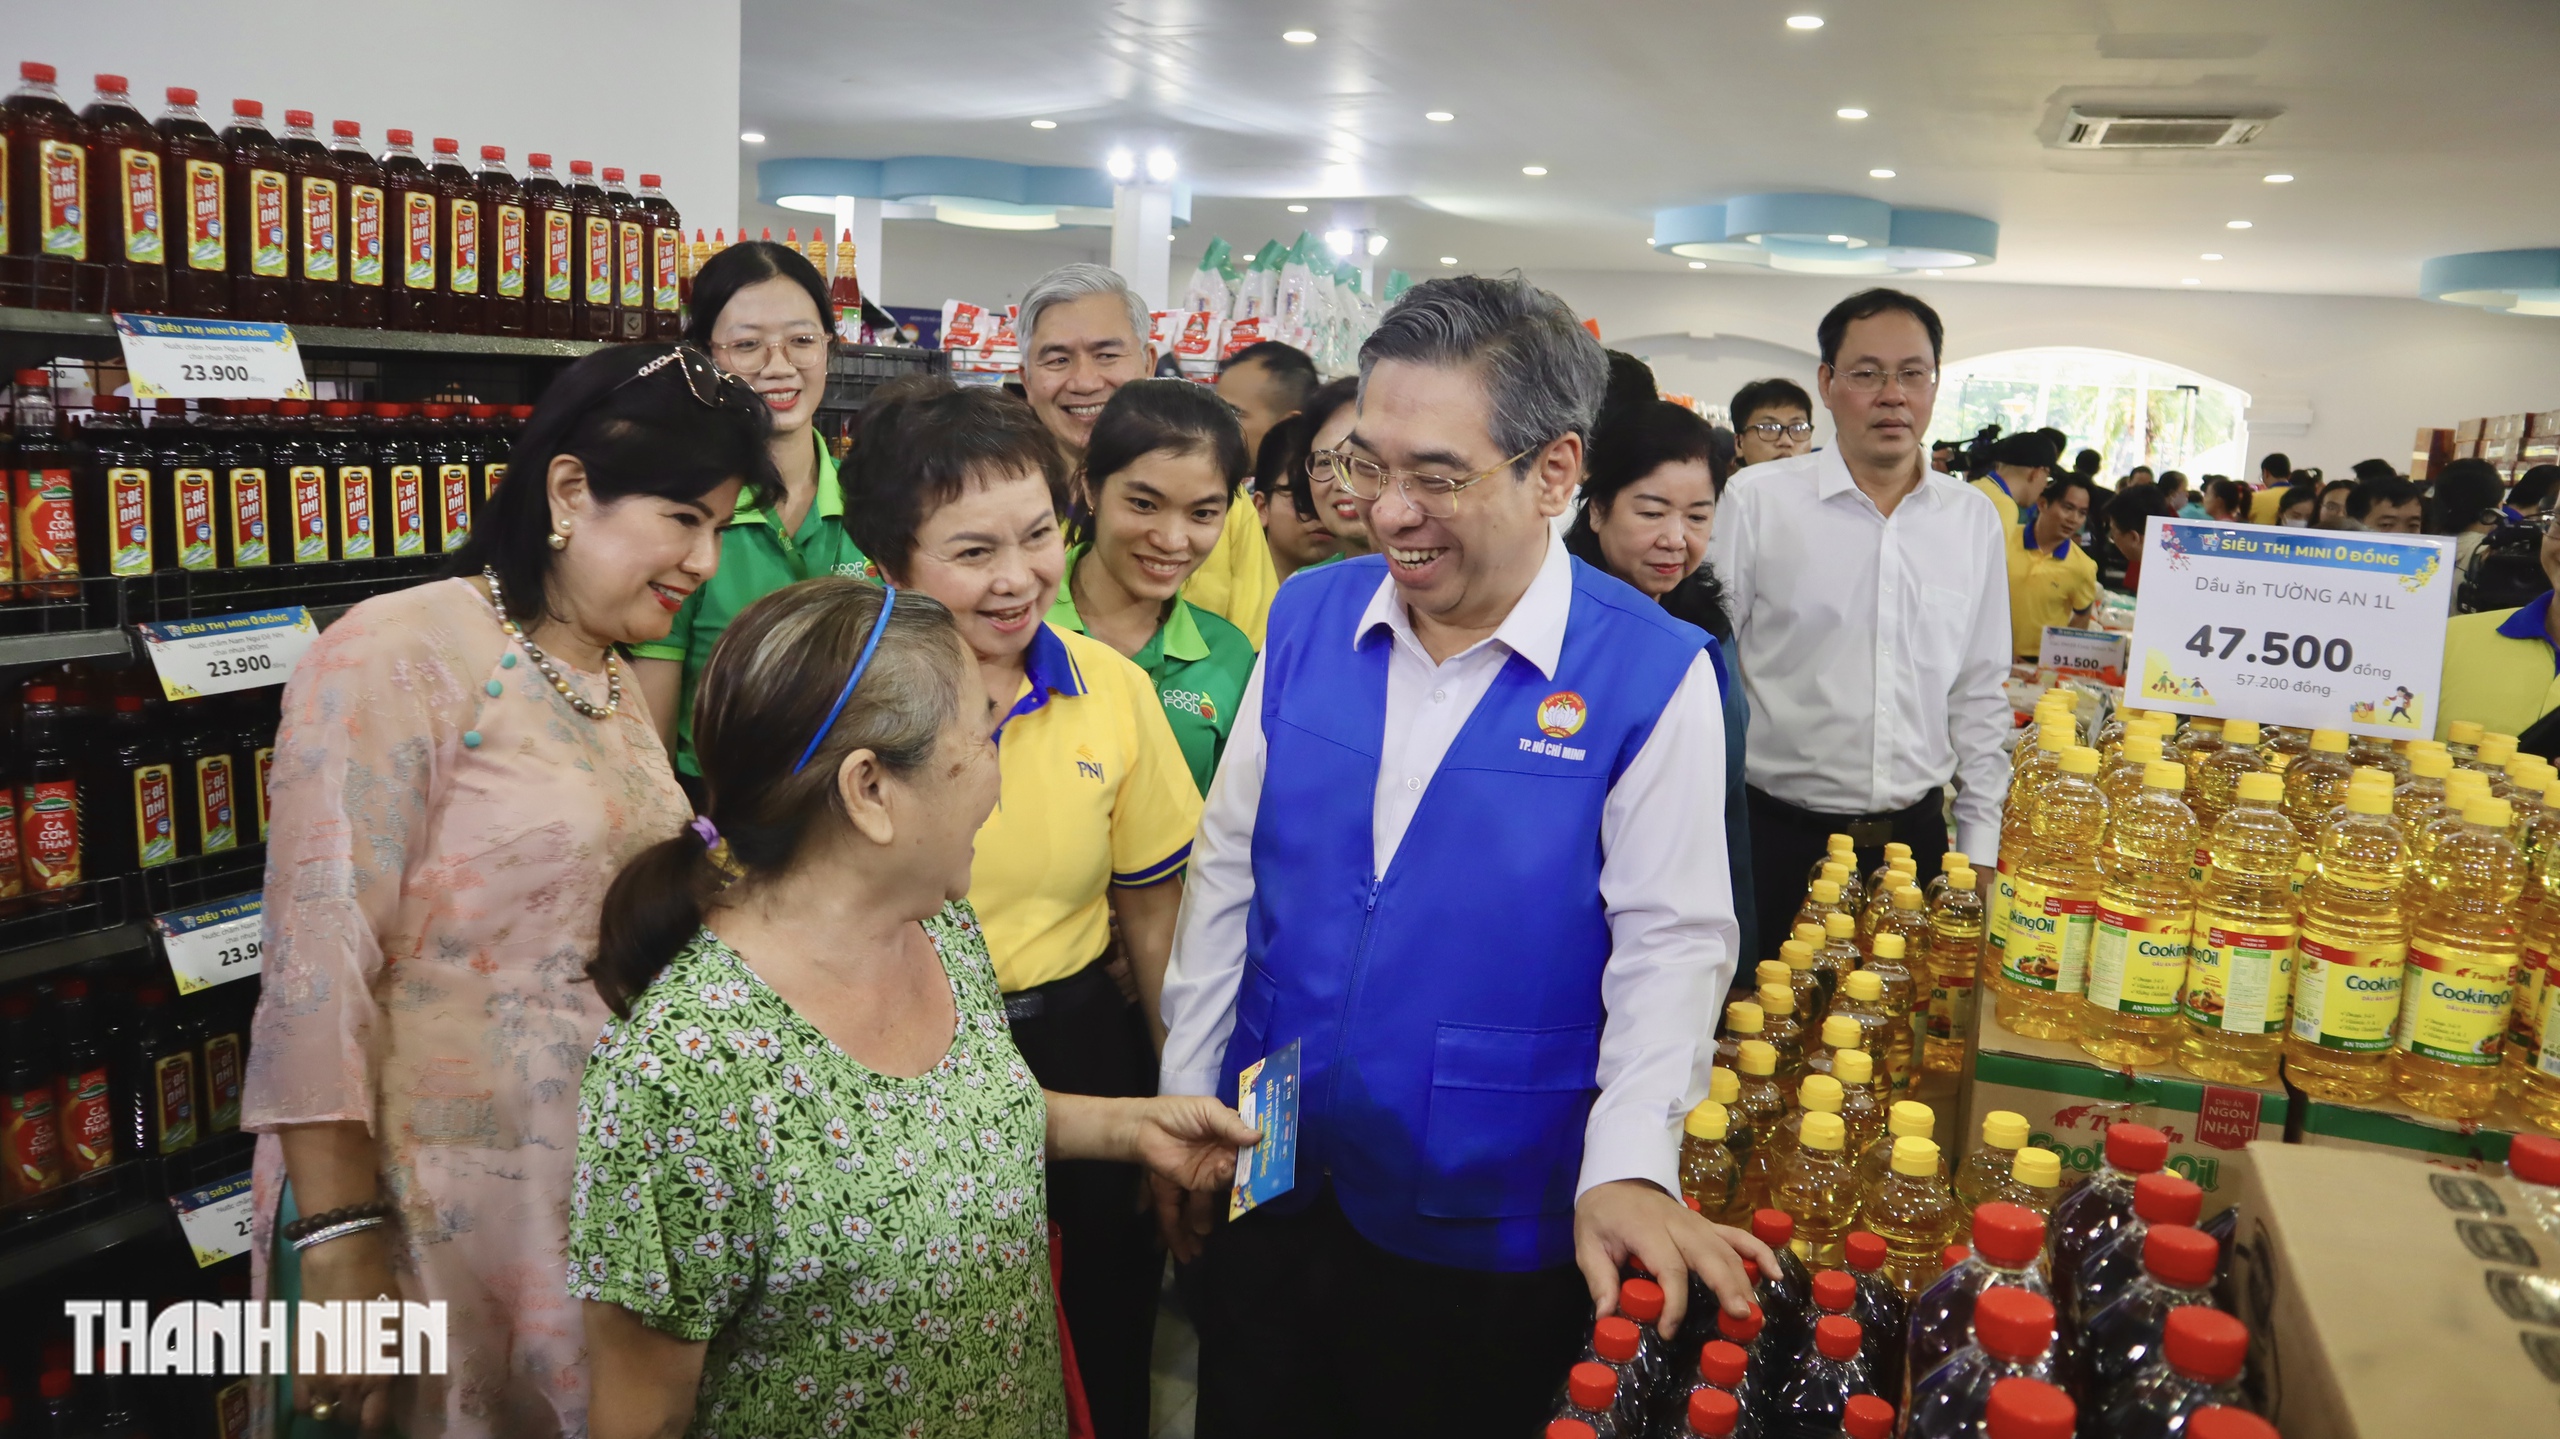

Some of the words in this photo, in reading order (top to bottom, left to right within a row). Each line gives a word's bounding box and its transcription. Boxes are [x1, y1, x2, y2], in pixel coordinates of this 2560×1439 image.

[157, 323, 183, 333] SIÊU
[185, 325, 204, 336] THỊ
[206, 326, 229, 336] MINI
[230, 326, 239, 336] 0
[241, 327, 271, 338] ĐỒNG
[181, 364, 249, 382] 23.900
[2221, 538, 2258, 553] SIÊU
[2262, 542, 2290, 558] THỊ
[2295, 546, 2332, 559] MINI
[2334, 546, 2348, 561] 0
[2349, 548, 2400, 566] ĐỒNG
[2195, 576, 2230, 593] Dầu
[2236, 580, 2256, 596] ăn
[2262, 580, 2332, 603] TƯỜNG
[2337, 591, 2367, 607] AN
[2374, 594, 2396, 610] 1L
[181, 623, 207, 635] SIÊU
[207, 622, 226, 631] THỊ
[227, 619, 250, 629] MINI
[251, 616, 260, 626] 0
[261, 614, 290, 624] ĐỒNG
[2053, 655, 2100, 670] 91.500
[2185, 624, 2354, 673] 47.500
[2353, 664, 2392, 681] đồng
[207, 654, 271, 678] 23.900
[2236, 673, 2289, 691] 57.200
[2293, 680, 2331, 698] đồng
[1164, 698, 1201, 715] FOOD
[1519, 738, 1532, 752] TP.
[1532, 738, 1547, 754] HỒ
[1545, 743, 1563, 758] CHÍ
[1562, 747, 1587, 762] MINH
[1076, 761, 1105, 785] PNJ
[196, 911, 220, 924] SIÊU
[220, 907, 239, 916] THỊ
[240, 901, 262, 913] MINI
[218, 941, 264, 967] 23.9
[2208, 1106, 2250, 1120] NGON
[209, 1185, 233, 1199] SIÊU
